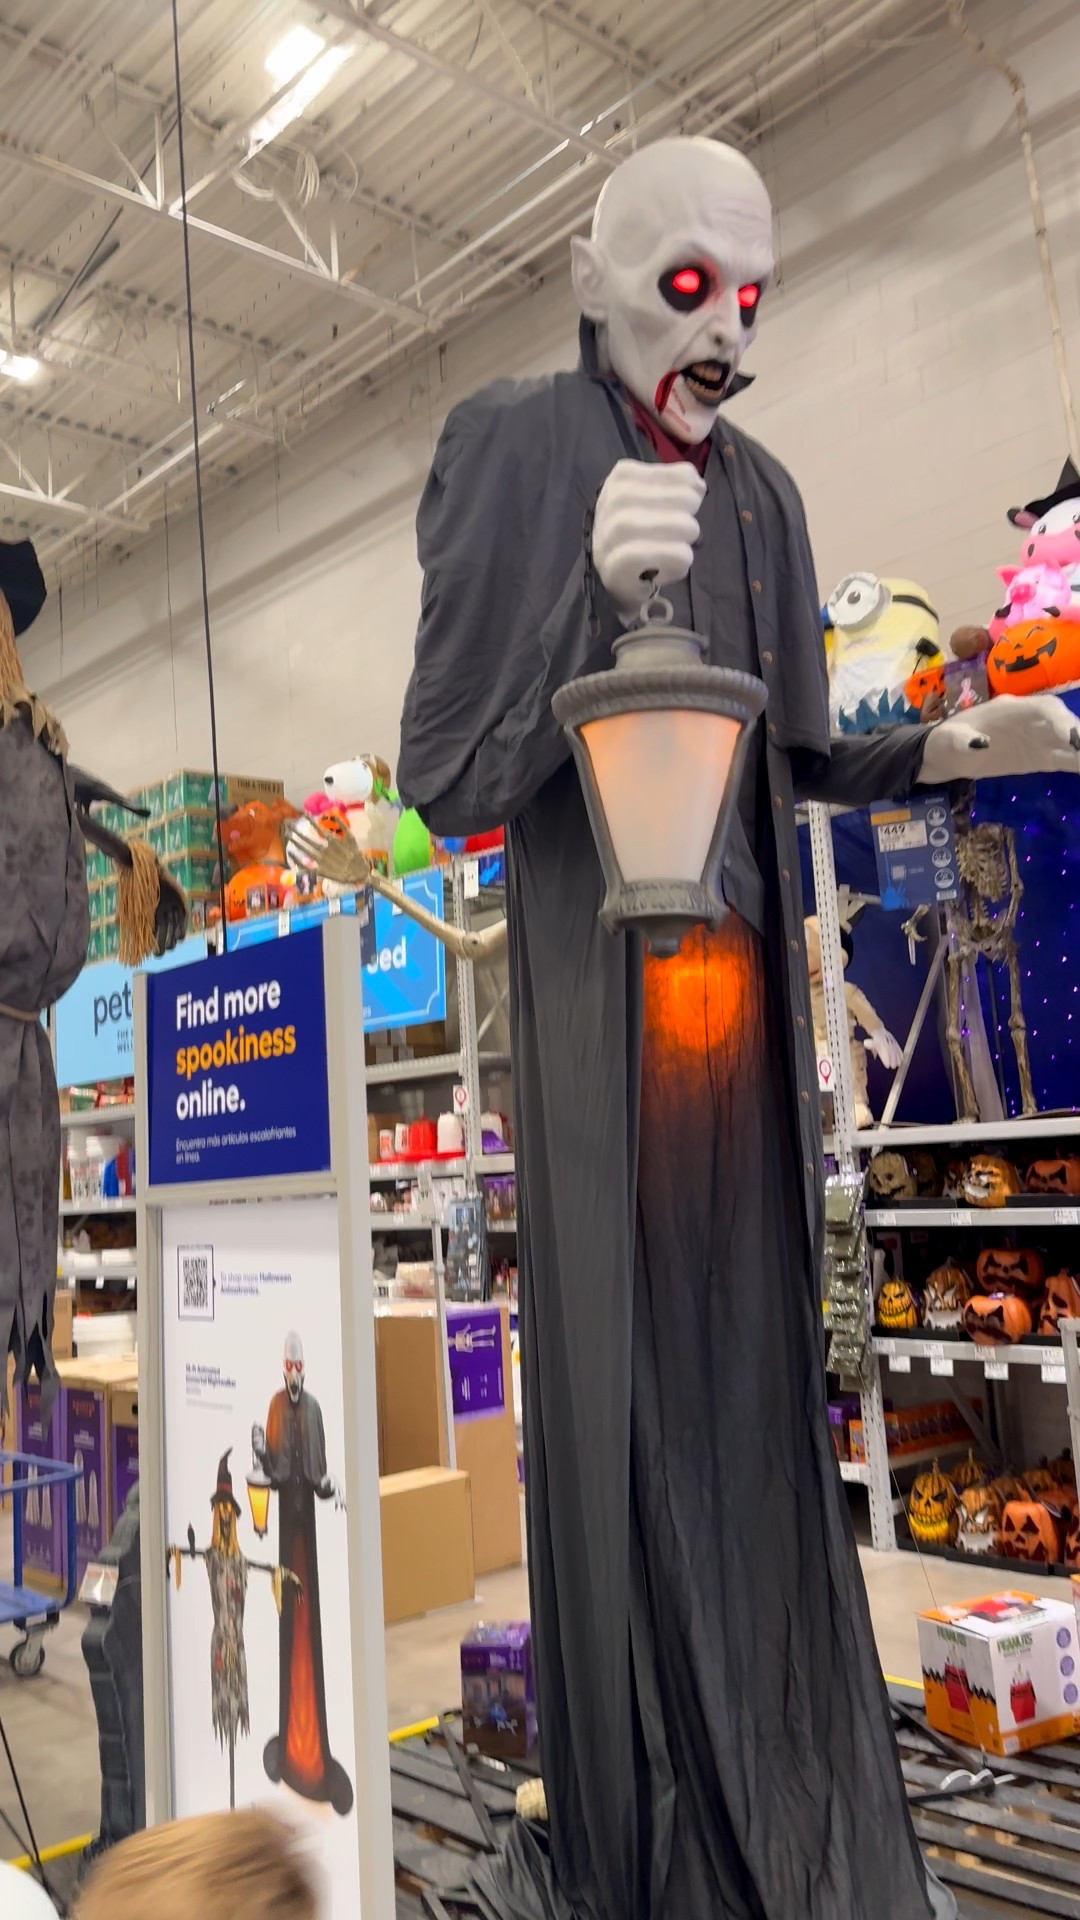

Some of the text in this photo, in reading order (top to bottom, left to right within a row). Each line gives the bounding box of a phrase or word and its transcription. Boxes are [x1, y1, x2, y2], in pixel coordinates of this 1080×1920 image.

[94, 980, 134, 1037] pet
[176, 980, 281, 1031] Find more
[176, 1024, 297, 1081] spookiness
[176, 1077, 246, 1120] online.
[260, 1272, 292, 1283] Halloween
